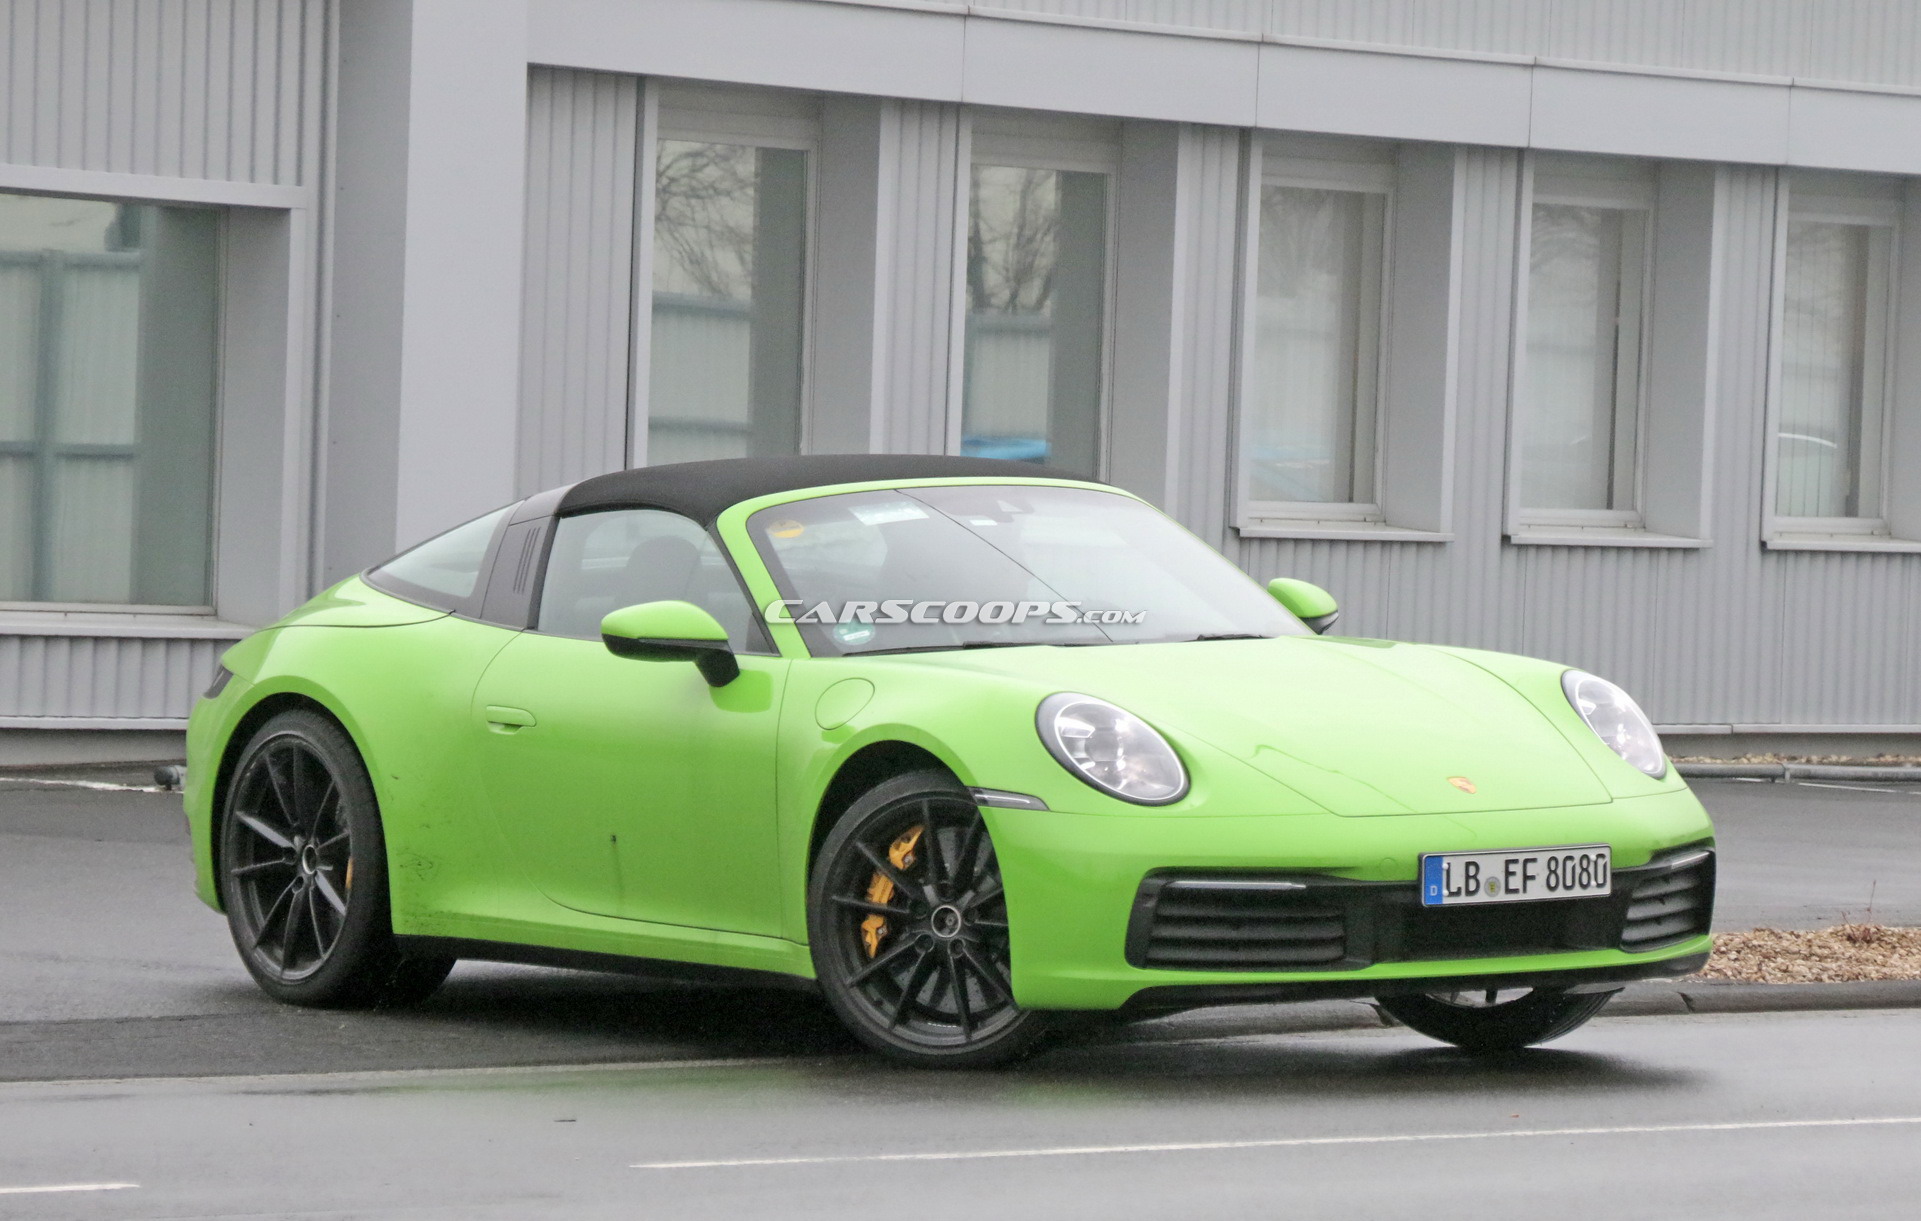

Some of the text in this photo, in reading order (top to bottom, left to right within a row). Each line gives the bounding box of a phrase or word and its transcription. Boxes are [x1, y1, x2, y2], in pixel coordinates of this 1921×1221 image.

[1445, 853, 1607, 897] LB EF 8080
[1430, 885, 1438, 896] D
